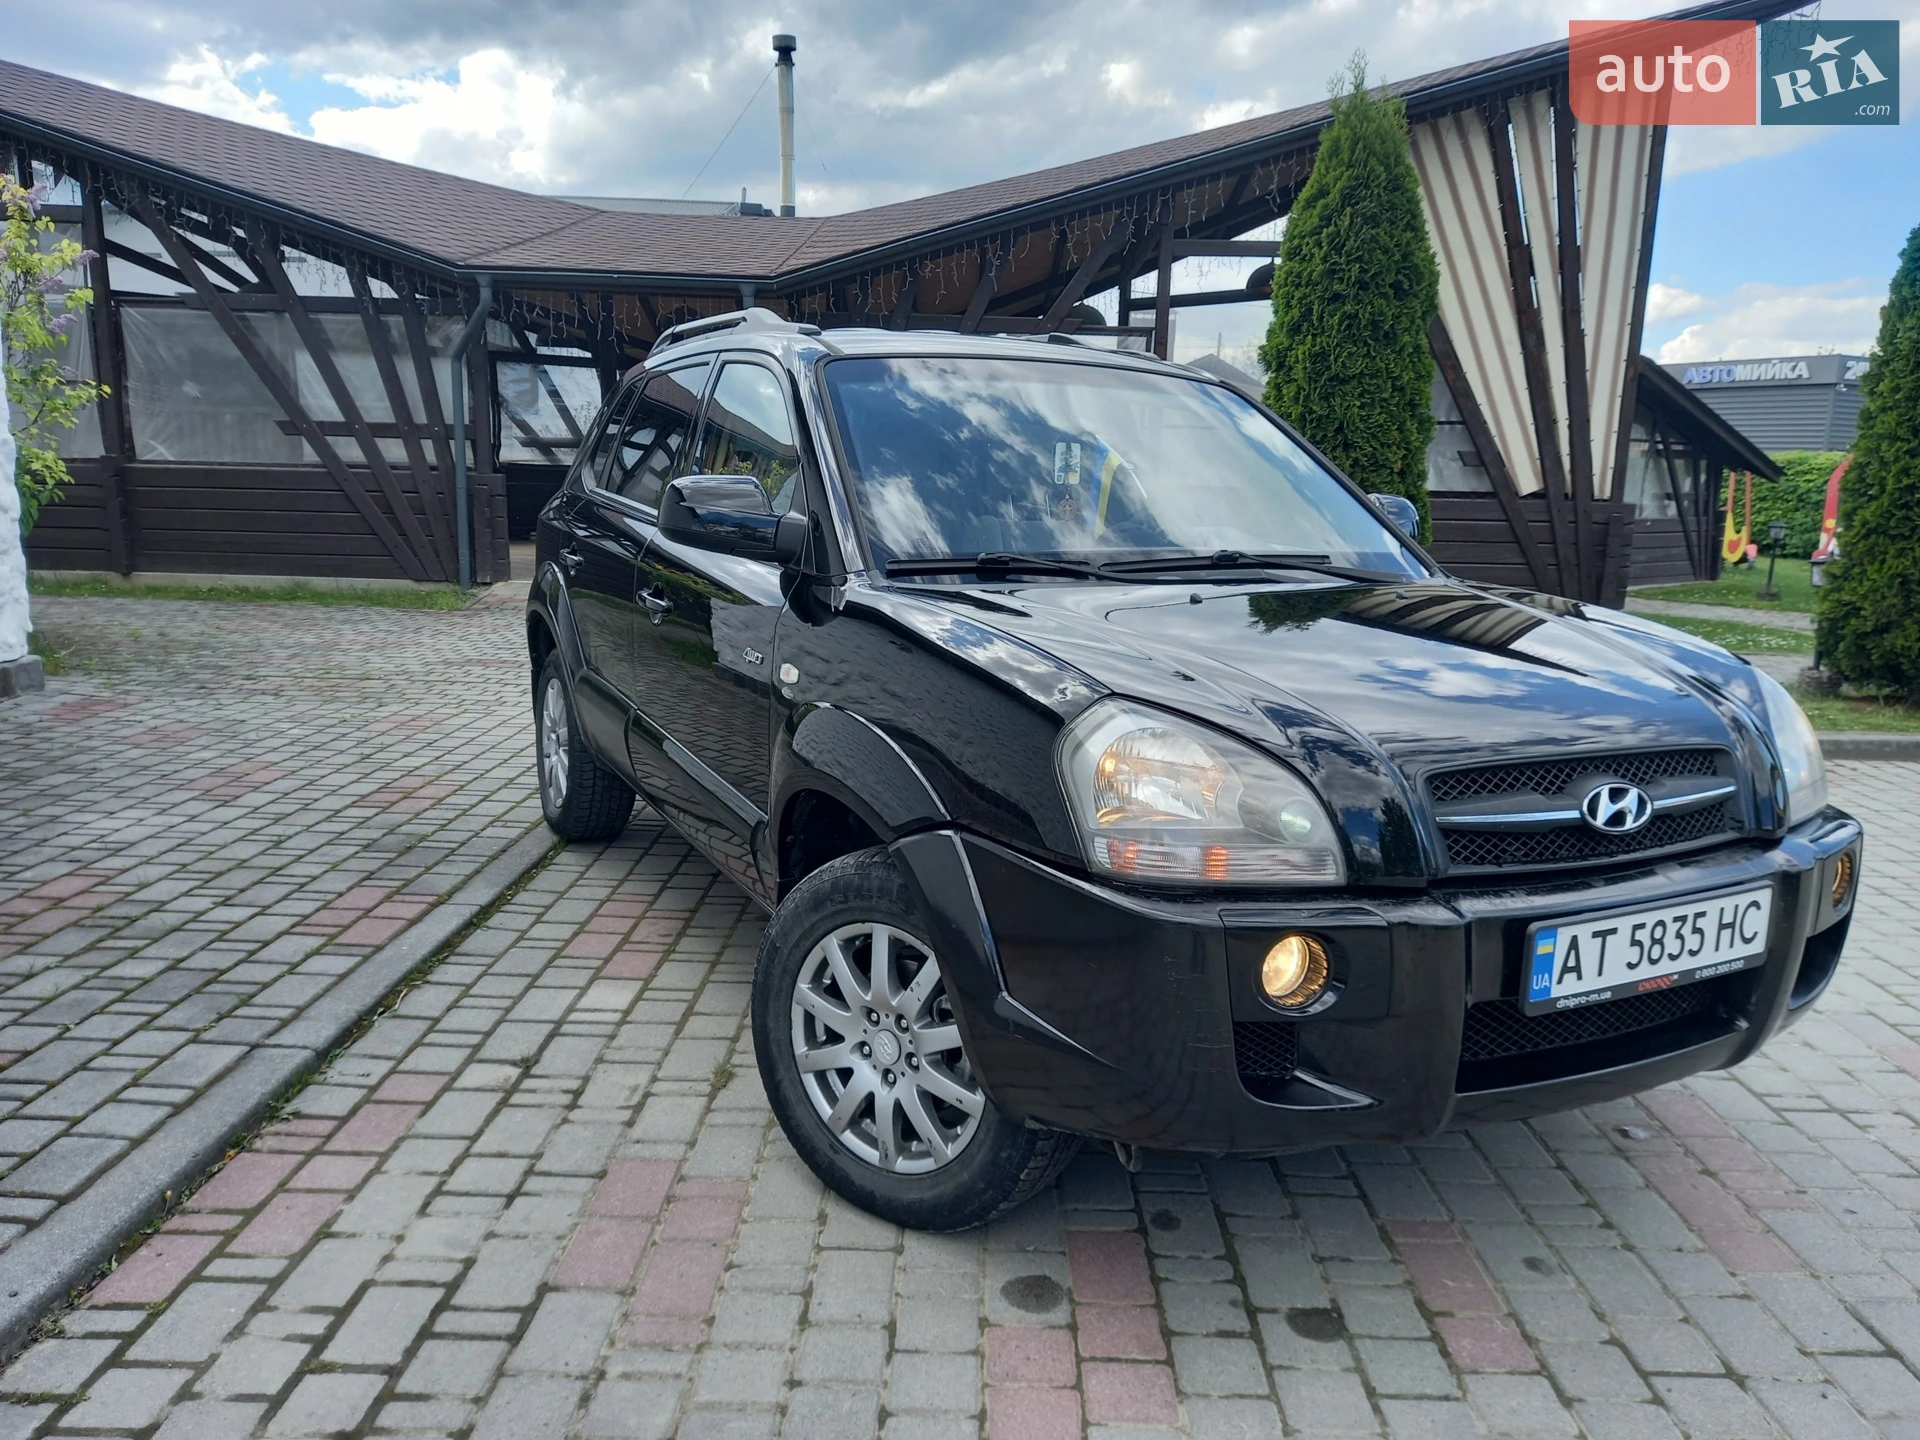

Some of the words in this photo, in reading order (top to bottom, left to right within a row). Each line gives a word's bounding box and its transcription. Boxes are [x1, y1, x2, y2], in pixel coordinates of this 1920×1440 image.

[1682, 360, 1810, 384] АВТОМИЙКА
[1556, 927, 1618, 985] AT
[1626, 910, 1708, 970] 5835
[1715, 900, 1762, 952] HC
[1533, 974, 1550, 990] UA
[1556, 990, 1613, 1009] dnipro-m.ua
